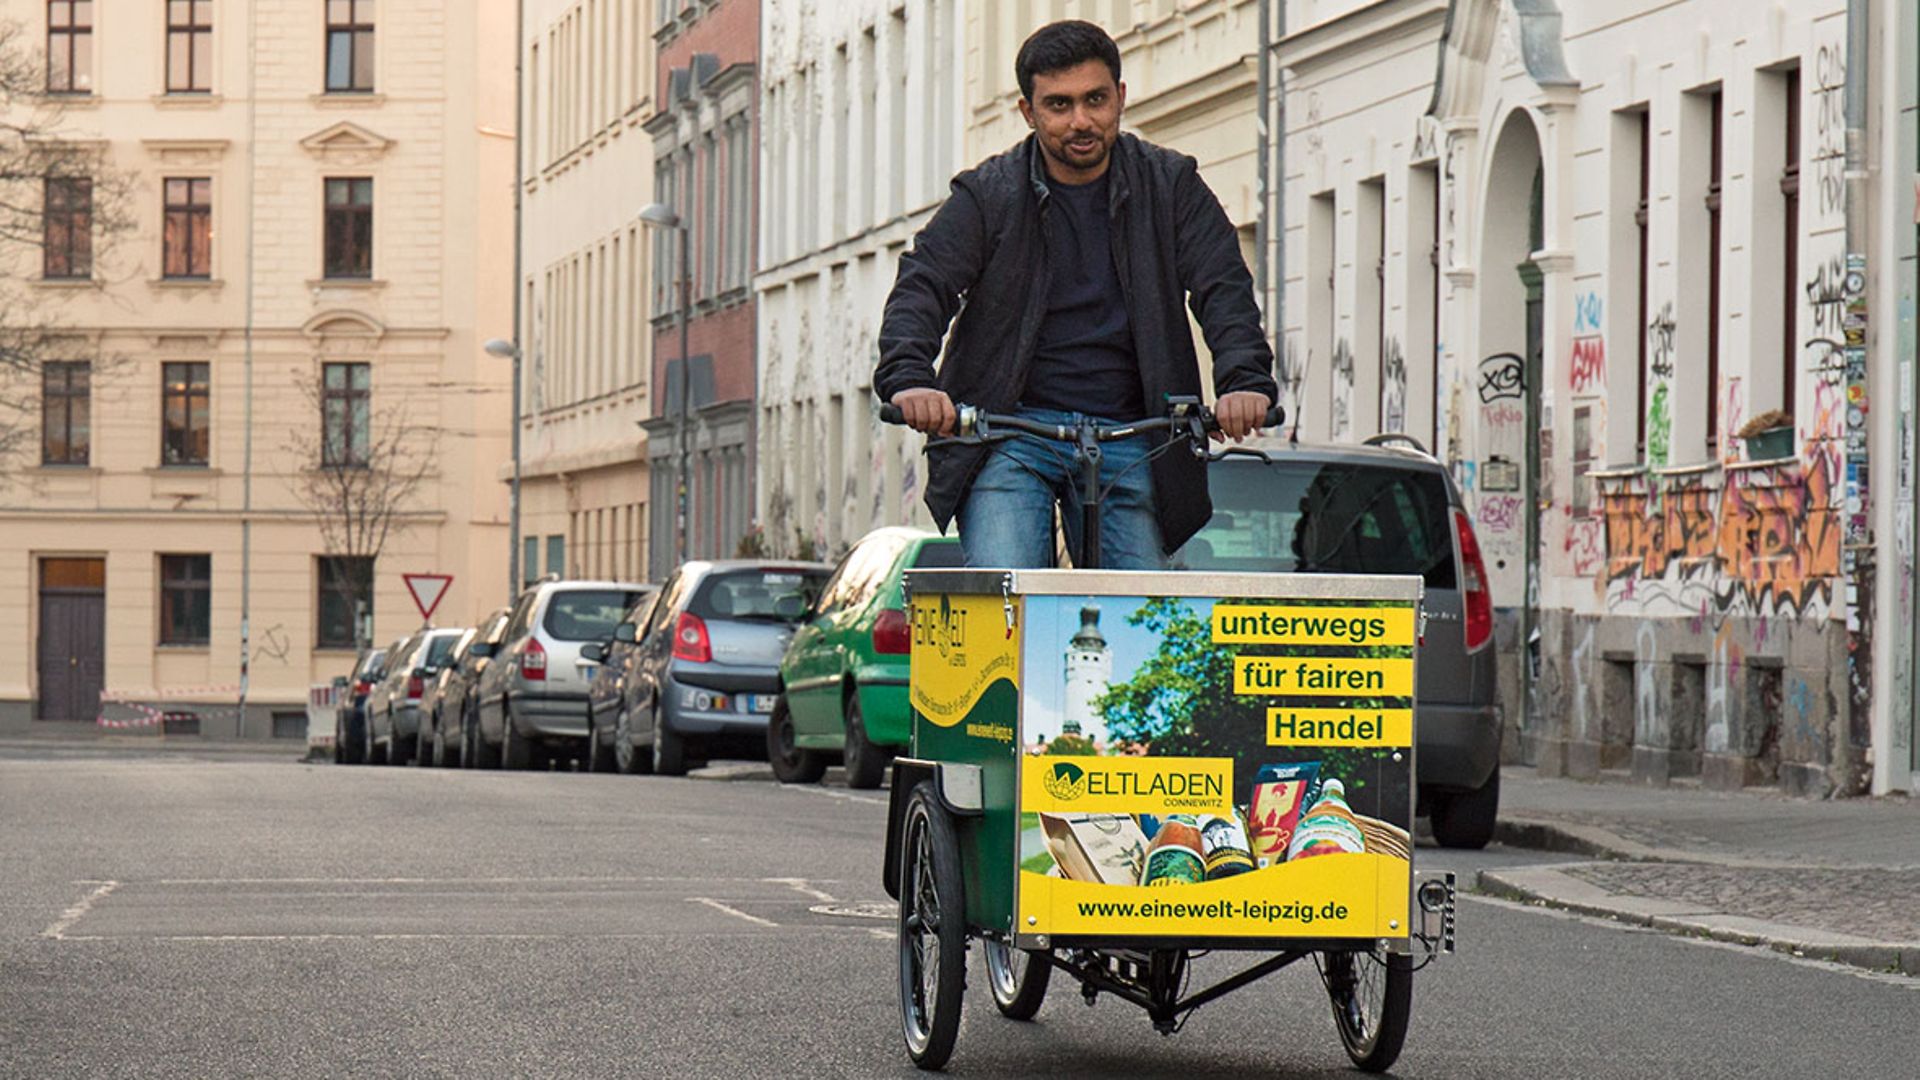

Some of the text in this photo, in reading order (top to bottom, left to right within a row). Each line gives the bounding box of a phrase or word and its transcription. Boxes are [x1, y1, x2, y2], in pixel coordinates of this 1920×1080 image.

[1221, 612, 1385, 642] unterwegs
[1243, 663, 1383, 694] für fairen
[1275, 714, 1382, 744] Handel
[1163, 799, 1223, 808] CONNEWITZ
[1078, 900, 1348, 923] www.einewelt-leipzig.de
